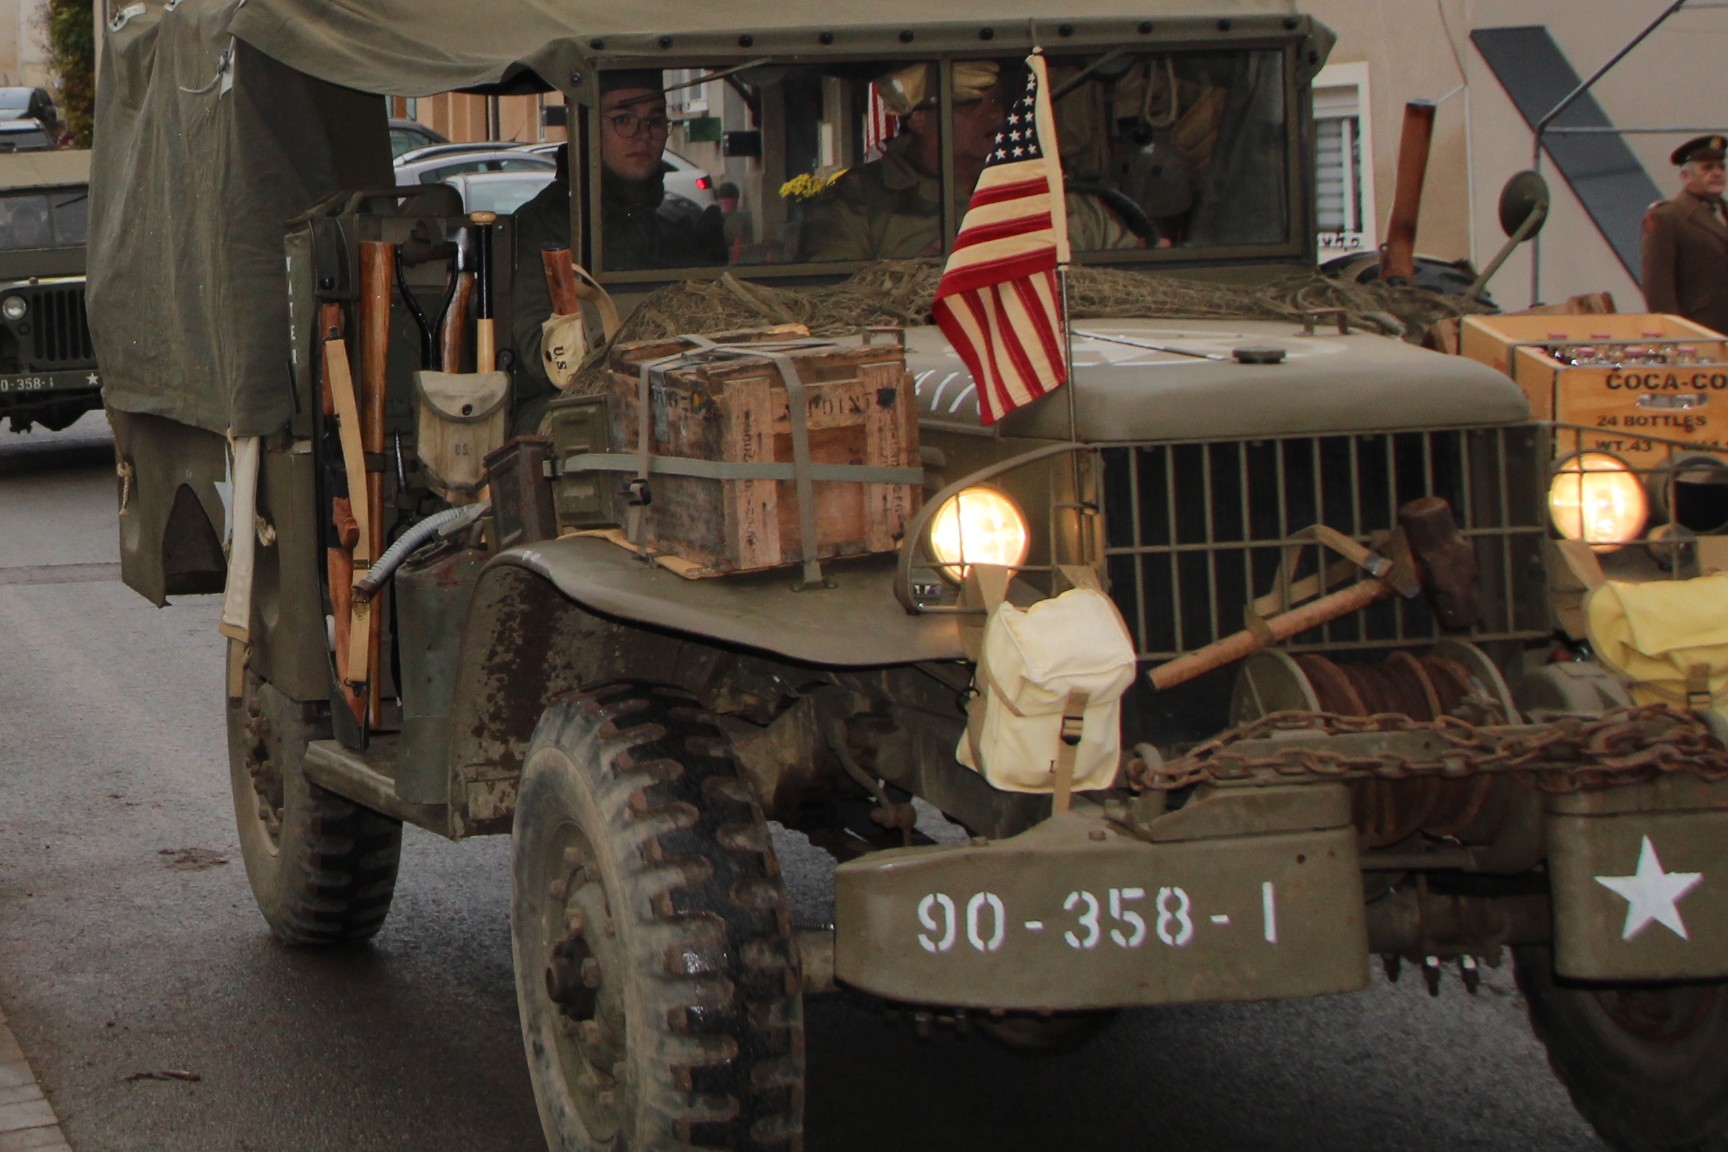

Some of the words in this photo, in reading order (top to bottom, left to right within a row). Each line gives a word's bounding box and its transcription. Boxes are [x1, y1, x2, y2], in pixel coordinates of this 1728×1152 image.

[553, 344, 568, 374] U.S.
[1596, 415, 1618, 427] 24
[1623, 415, 1707, 428] BOTTLES
